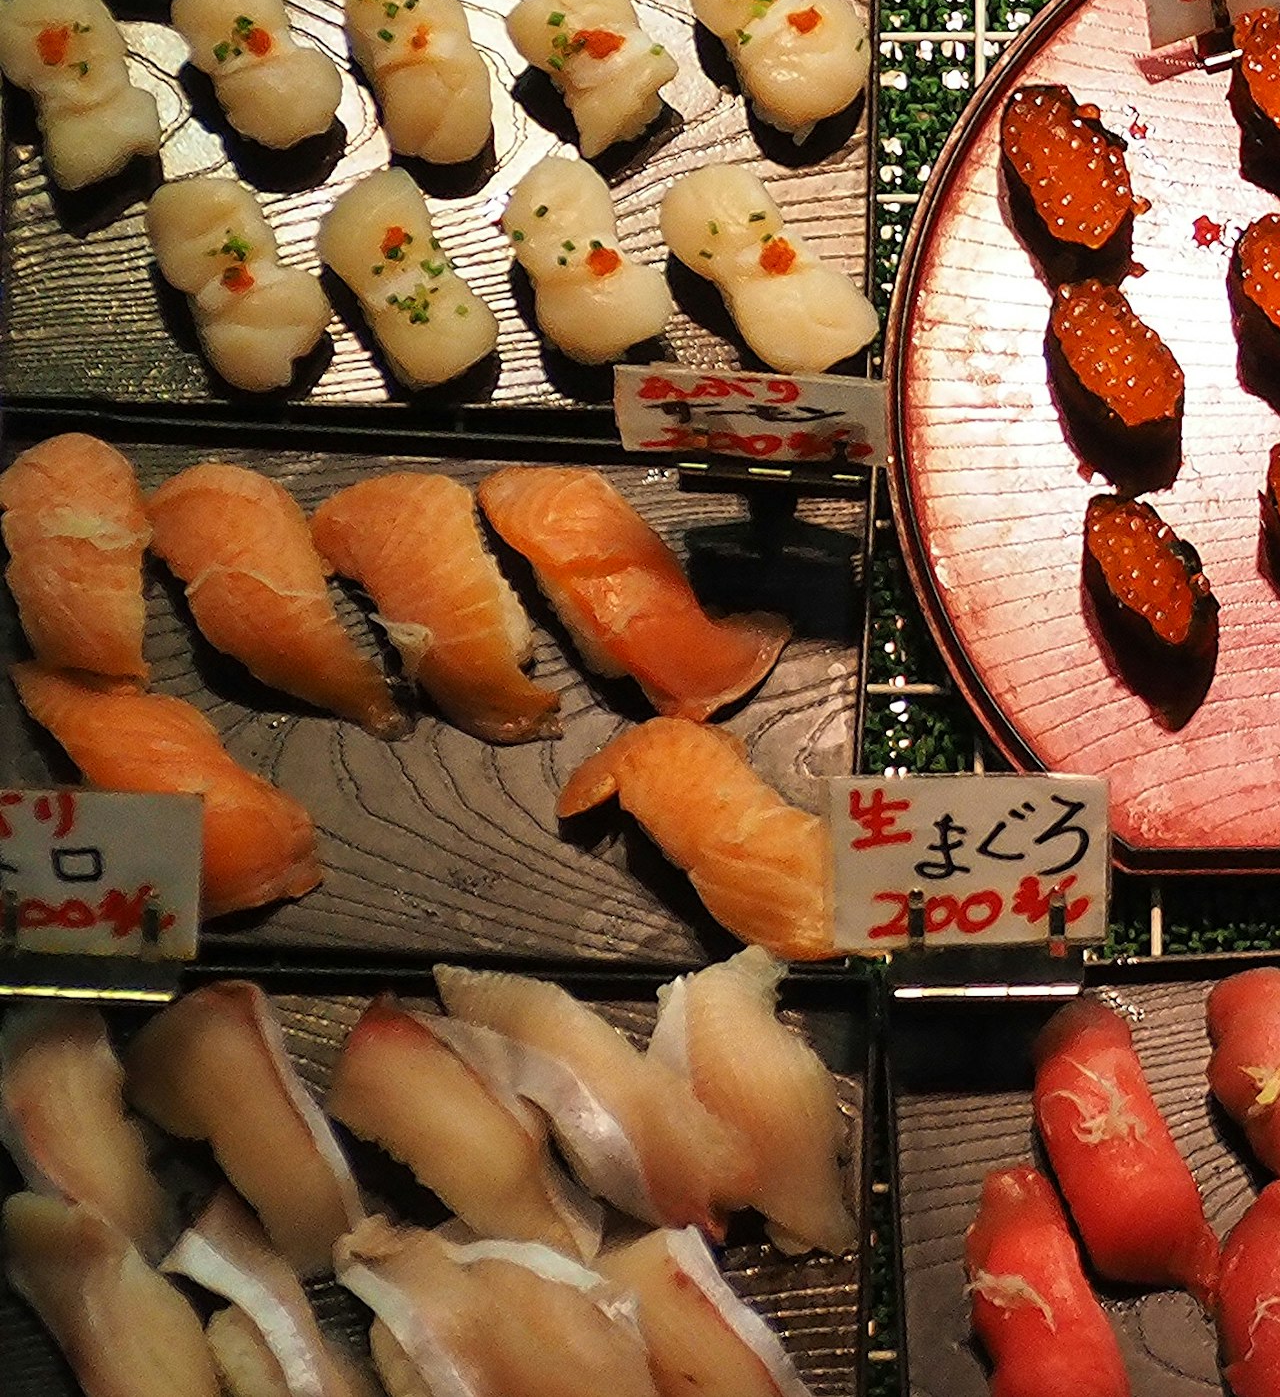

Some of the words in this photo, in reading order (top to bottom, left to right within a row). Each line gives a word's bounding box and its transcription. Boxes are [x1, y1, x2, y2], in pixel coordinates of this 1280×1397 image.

[642, 401, 847, 424] サーモン
[849, 788, 1090, 880] 生まぐろ
